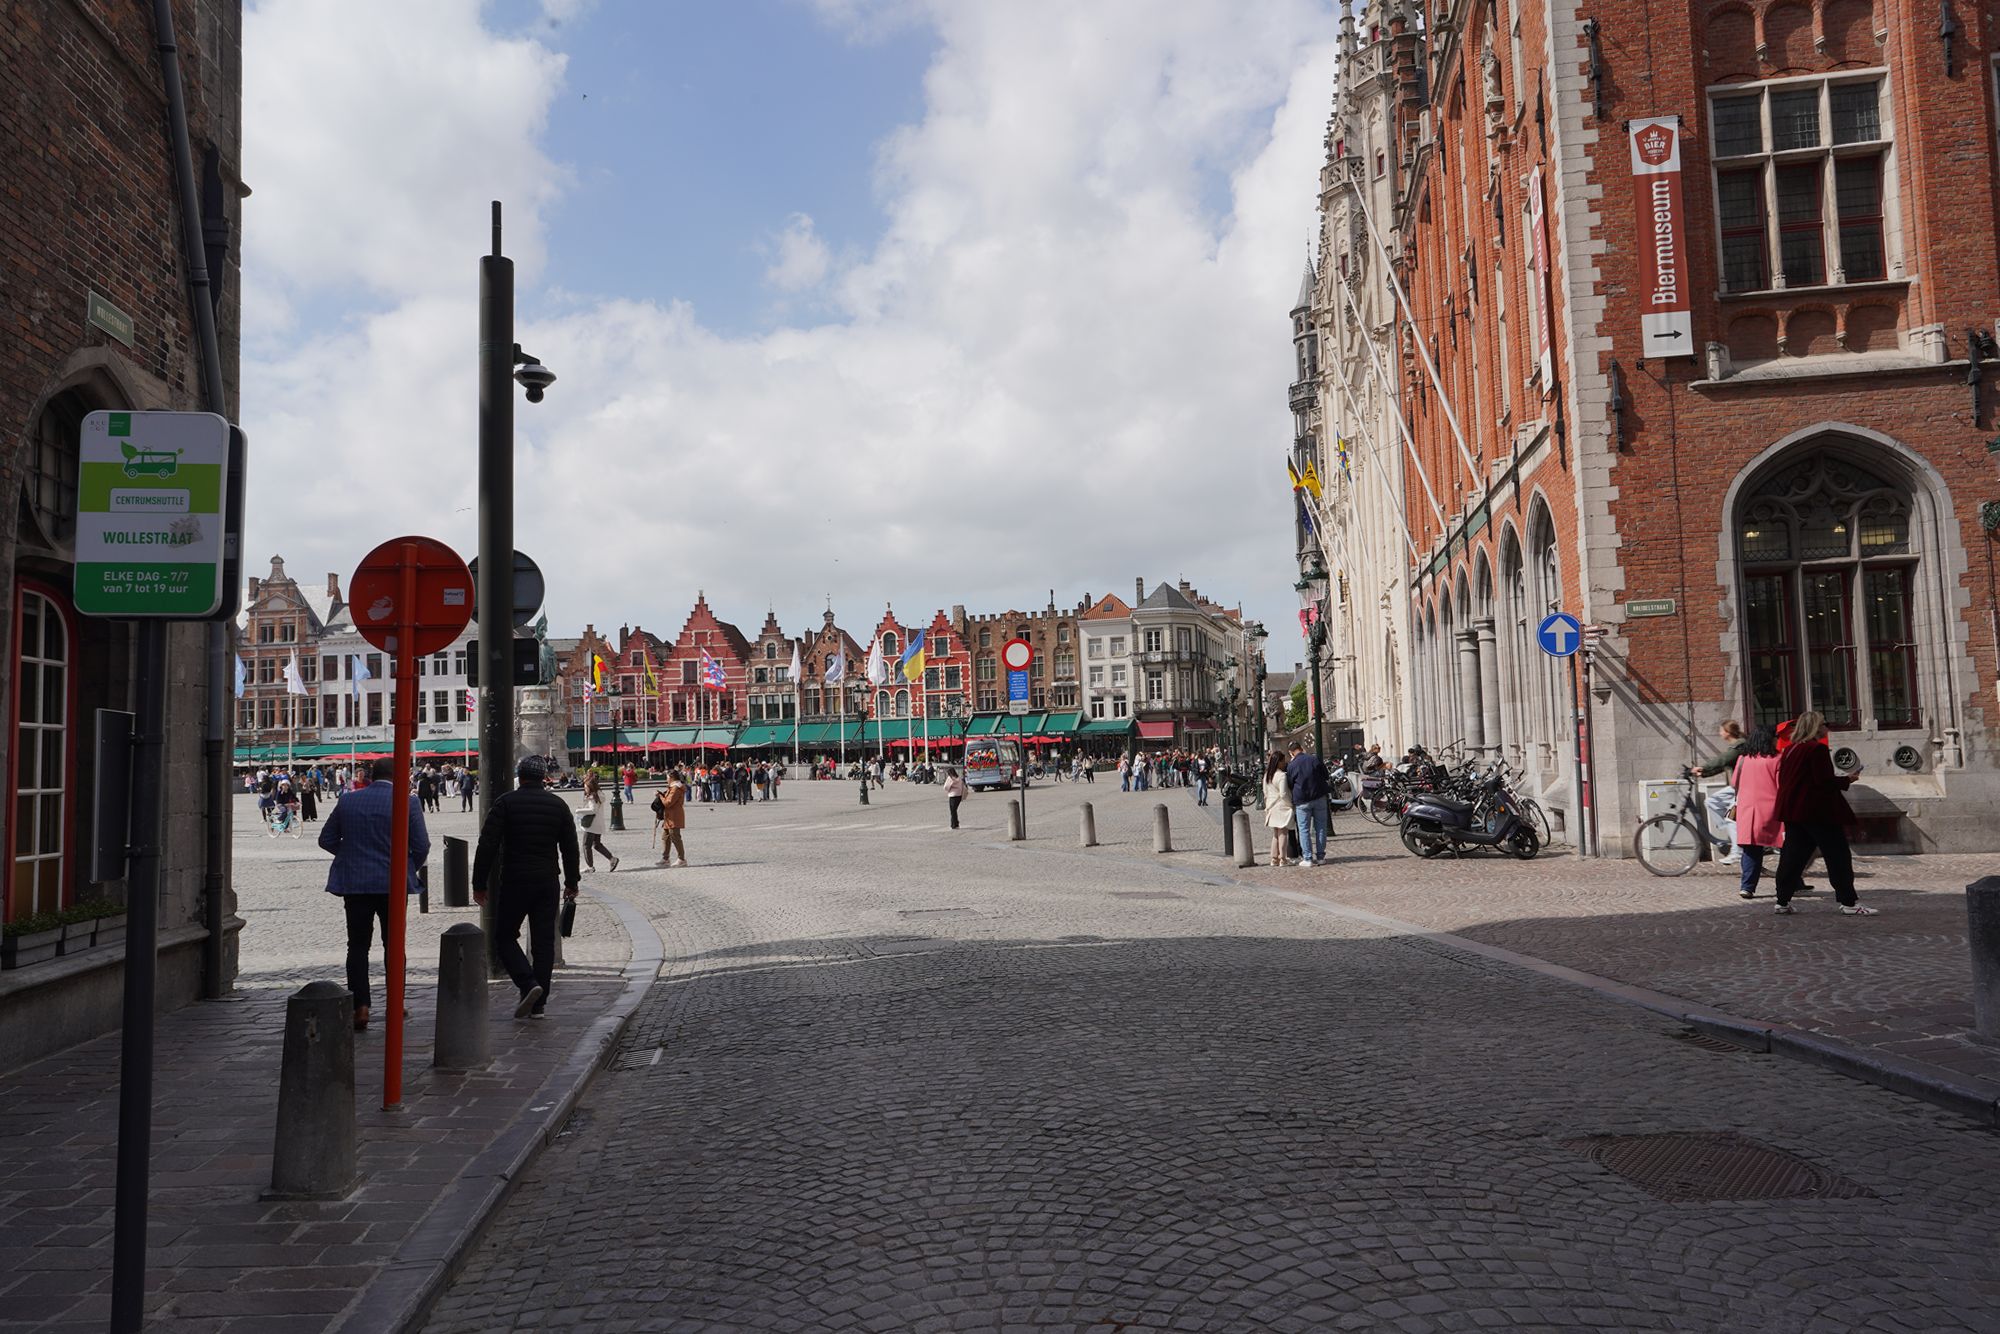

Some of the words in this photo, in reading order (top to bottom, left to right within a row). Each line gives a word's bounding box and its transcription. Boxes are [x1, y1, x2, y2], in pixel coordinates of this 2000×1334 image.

[1644, 140, 1666, 151] BIER
[1651, 179, 1677, 306] Biermuseum
[115, 495, 185, 506] CENTRUMSHUTTLE
[103, 531, 194, 545] WOLLESTRAAT
[103, 571, 134, 582] ELKE
[136, 571, 160, 582] DAG
[170, 571, 189, 582] 7/7
[103, 585, 123, 593] van
[125, 584, 132, 593] 7
[135, 584, 150, 593] tot
[153, 584, 166, 593] 19
[168, 585, 189, 593] uur
